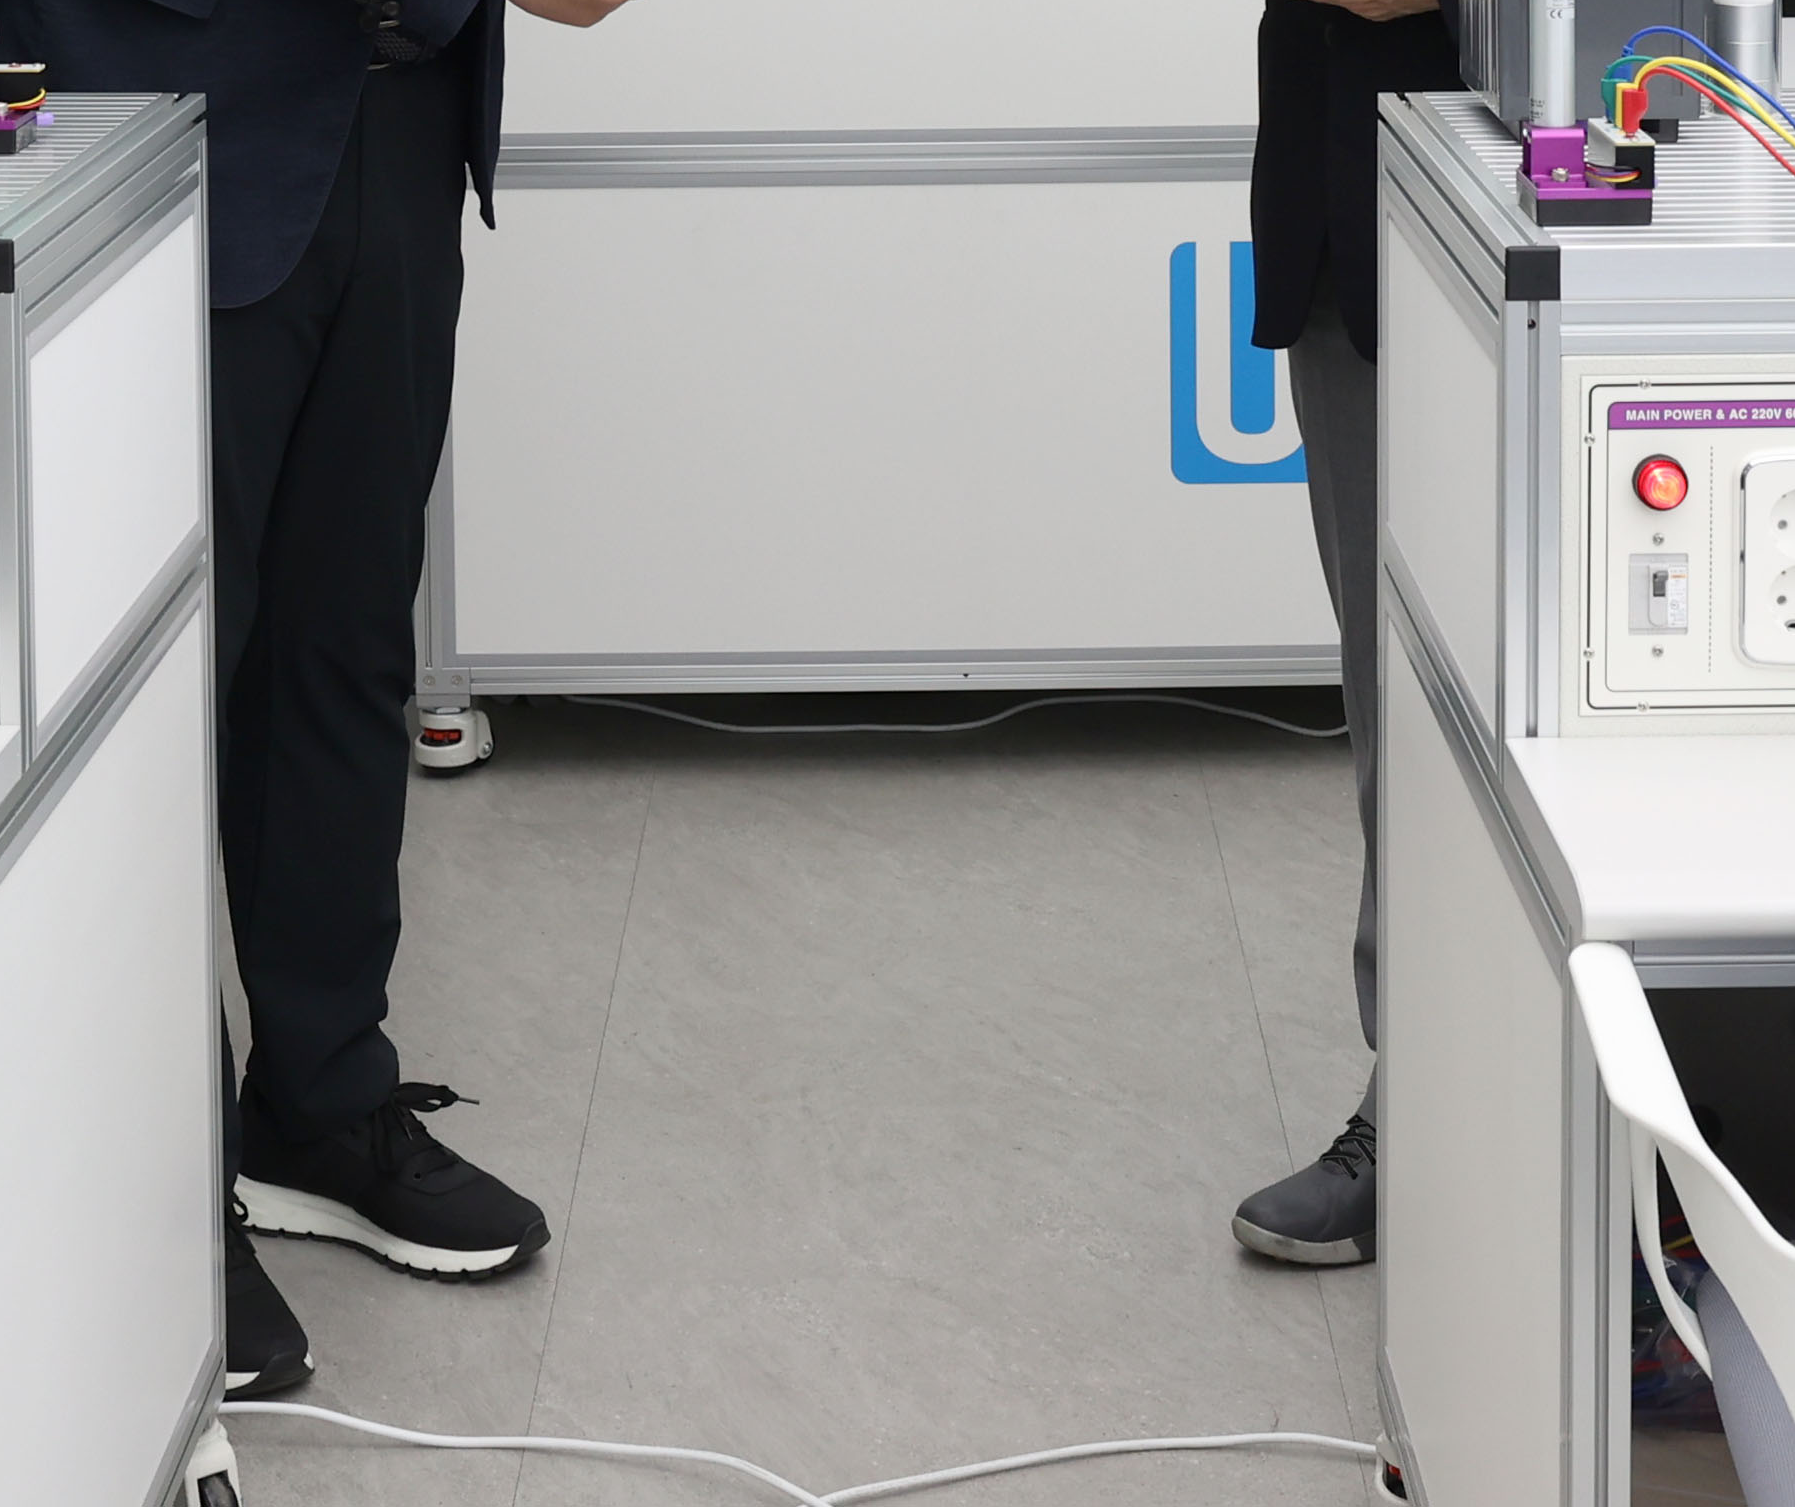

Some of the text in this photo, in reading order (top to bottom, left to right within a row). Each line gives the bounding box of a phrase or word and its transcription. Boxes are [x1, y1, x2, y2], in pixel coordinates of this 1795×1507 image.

[1626, 409, 1661, 420] MAIN
[1664, 409, 1712, 420] POWER
[1716, 408, 1725, 419] &
[1729, 408, 1748, 419] AC
[1751, 408, 1782, 419] 220V
